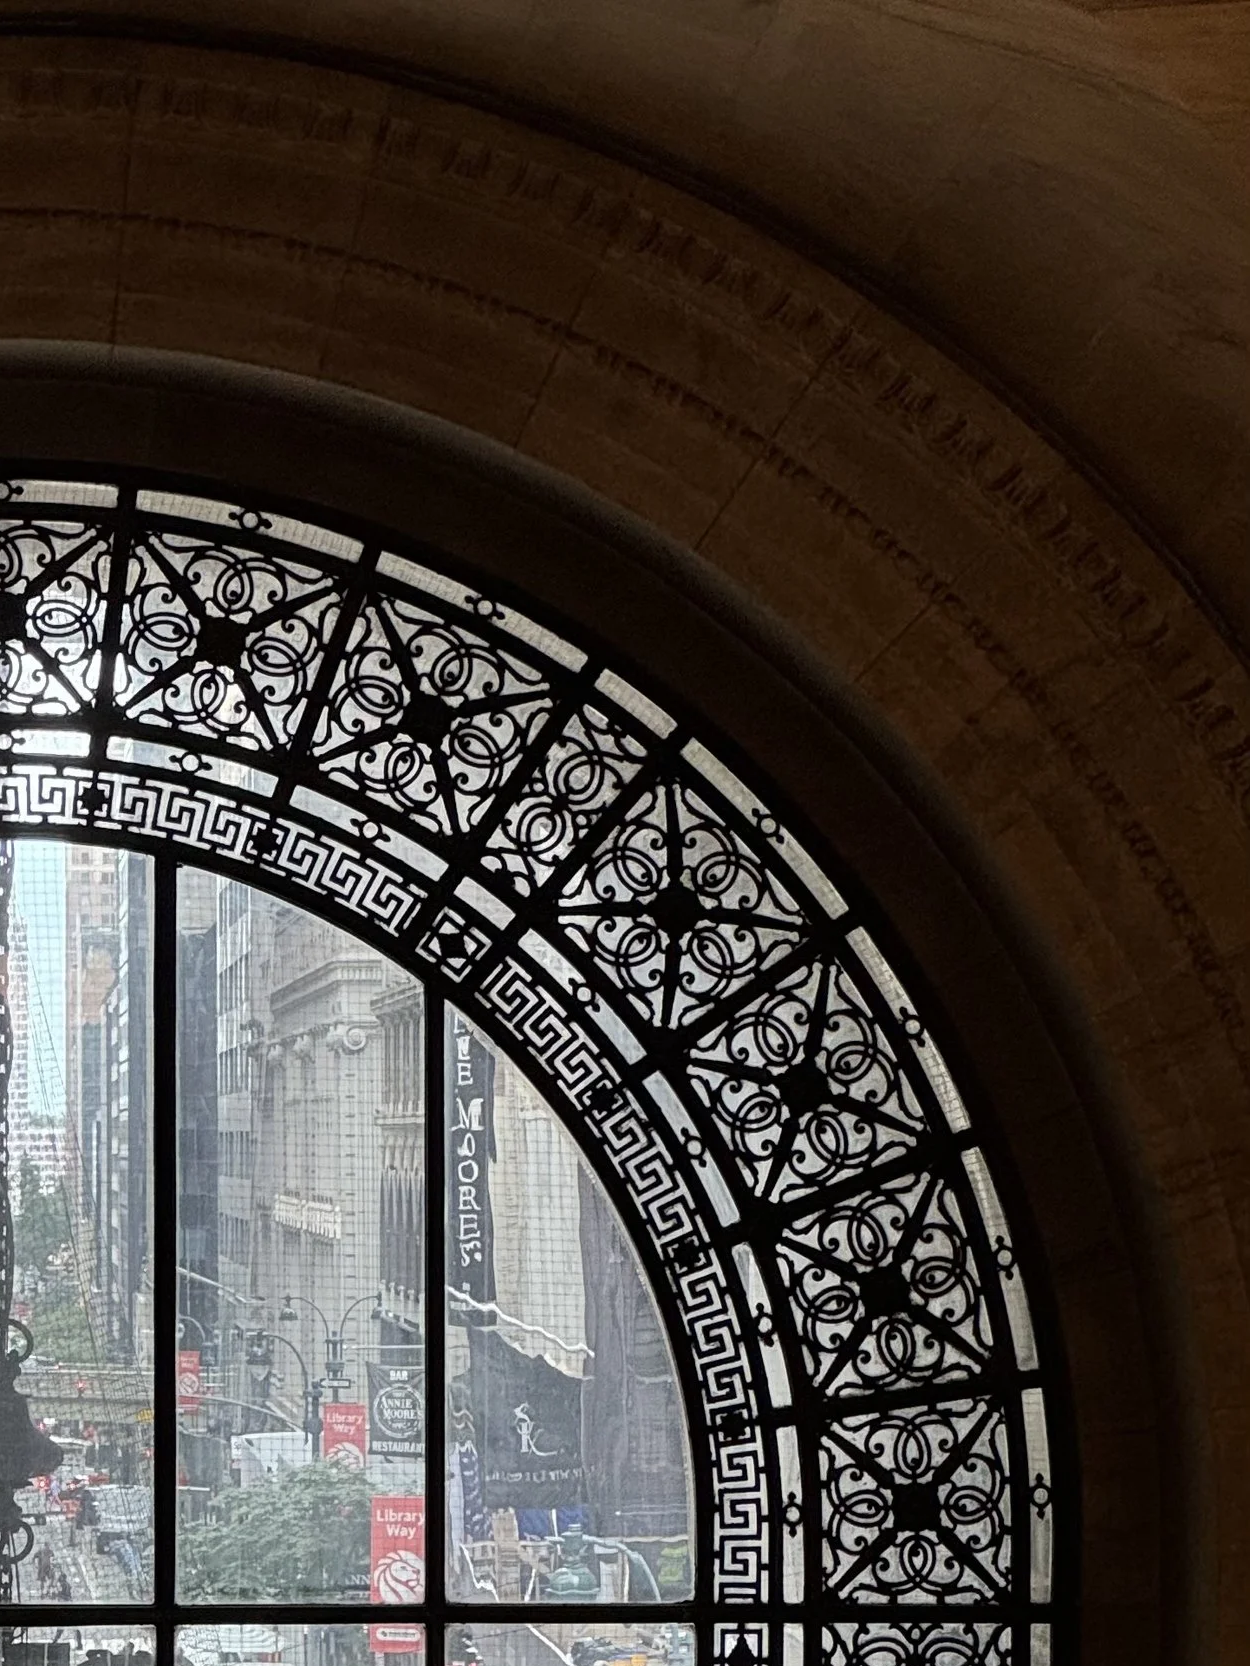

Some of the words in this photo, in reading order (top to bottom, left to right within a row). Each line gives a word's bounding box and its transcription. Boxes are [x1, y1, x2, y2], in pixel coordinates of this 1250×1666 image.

[390, 1370, 408, 1380] BAR
[380, 1396, 413, 1409] ANNIE
[326, 1413, 364, 1425] Library
[333, 1423, 356, 1436] Way
[376, 1509, 425, 1527] Library
[386, 1524, 417, 1539] Way
